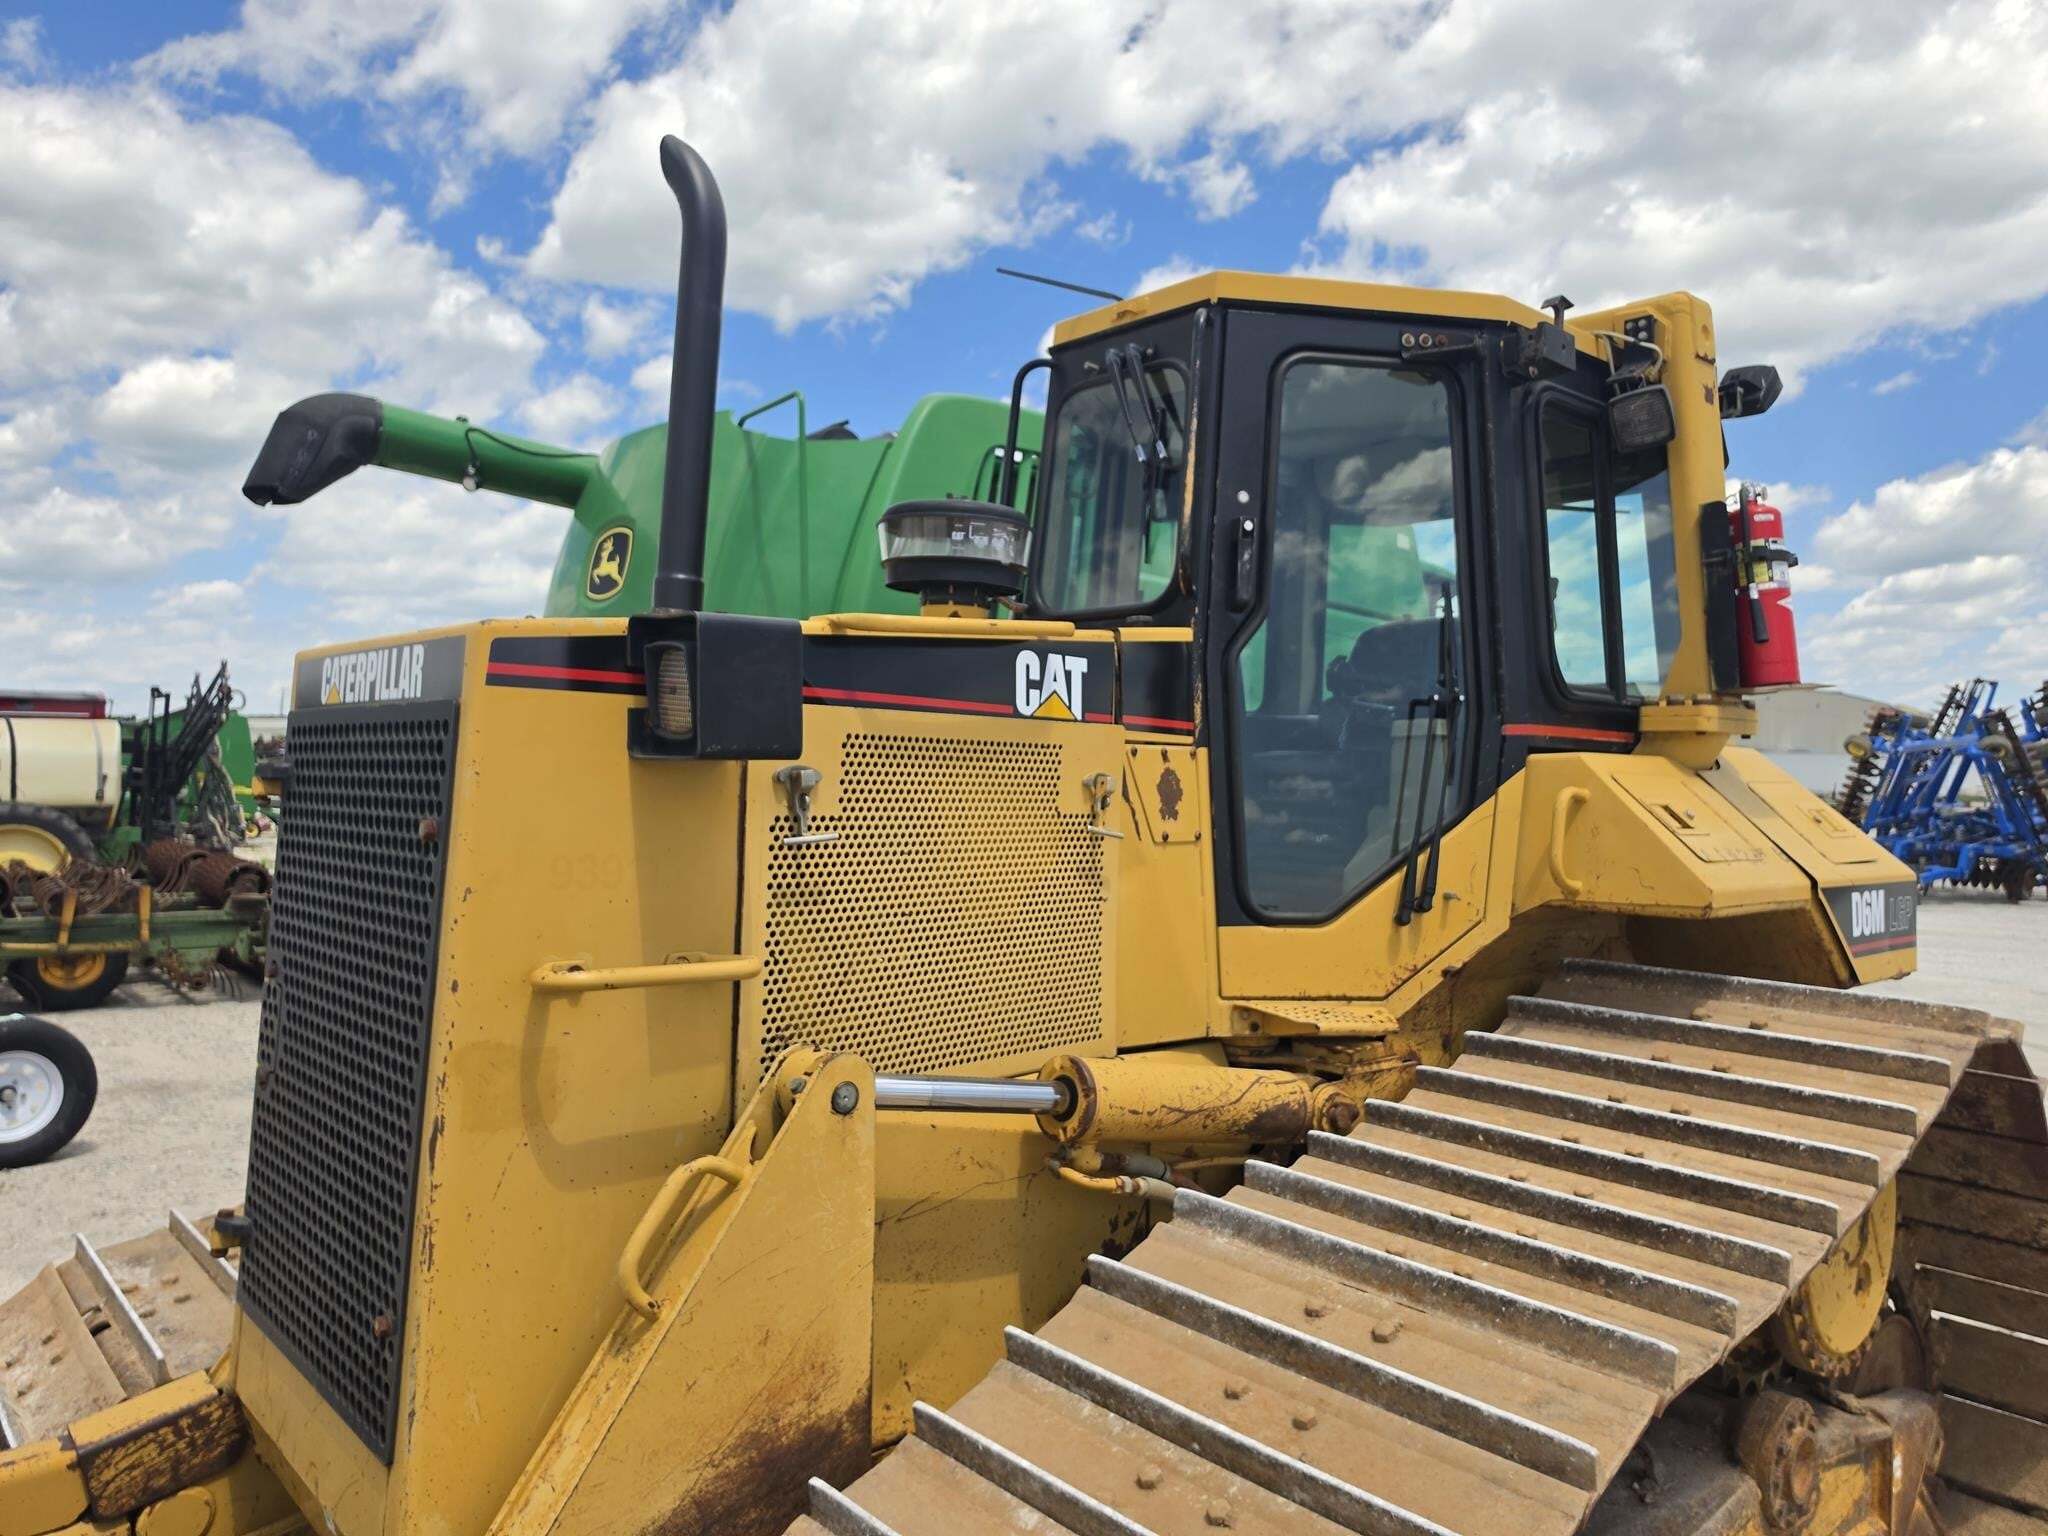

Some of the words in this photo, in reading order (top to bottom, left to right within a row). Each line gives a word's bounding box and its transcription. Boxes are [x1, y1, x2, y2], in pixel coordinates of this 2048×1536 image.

[321, 644, 424, 705] CATERPILLAR
[1015, 650, 1088, 721] CAT
[1851, 889, 1885, 938] D6M
